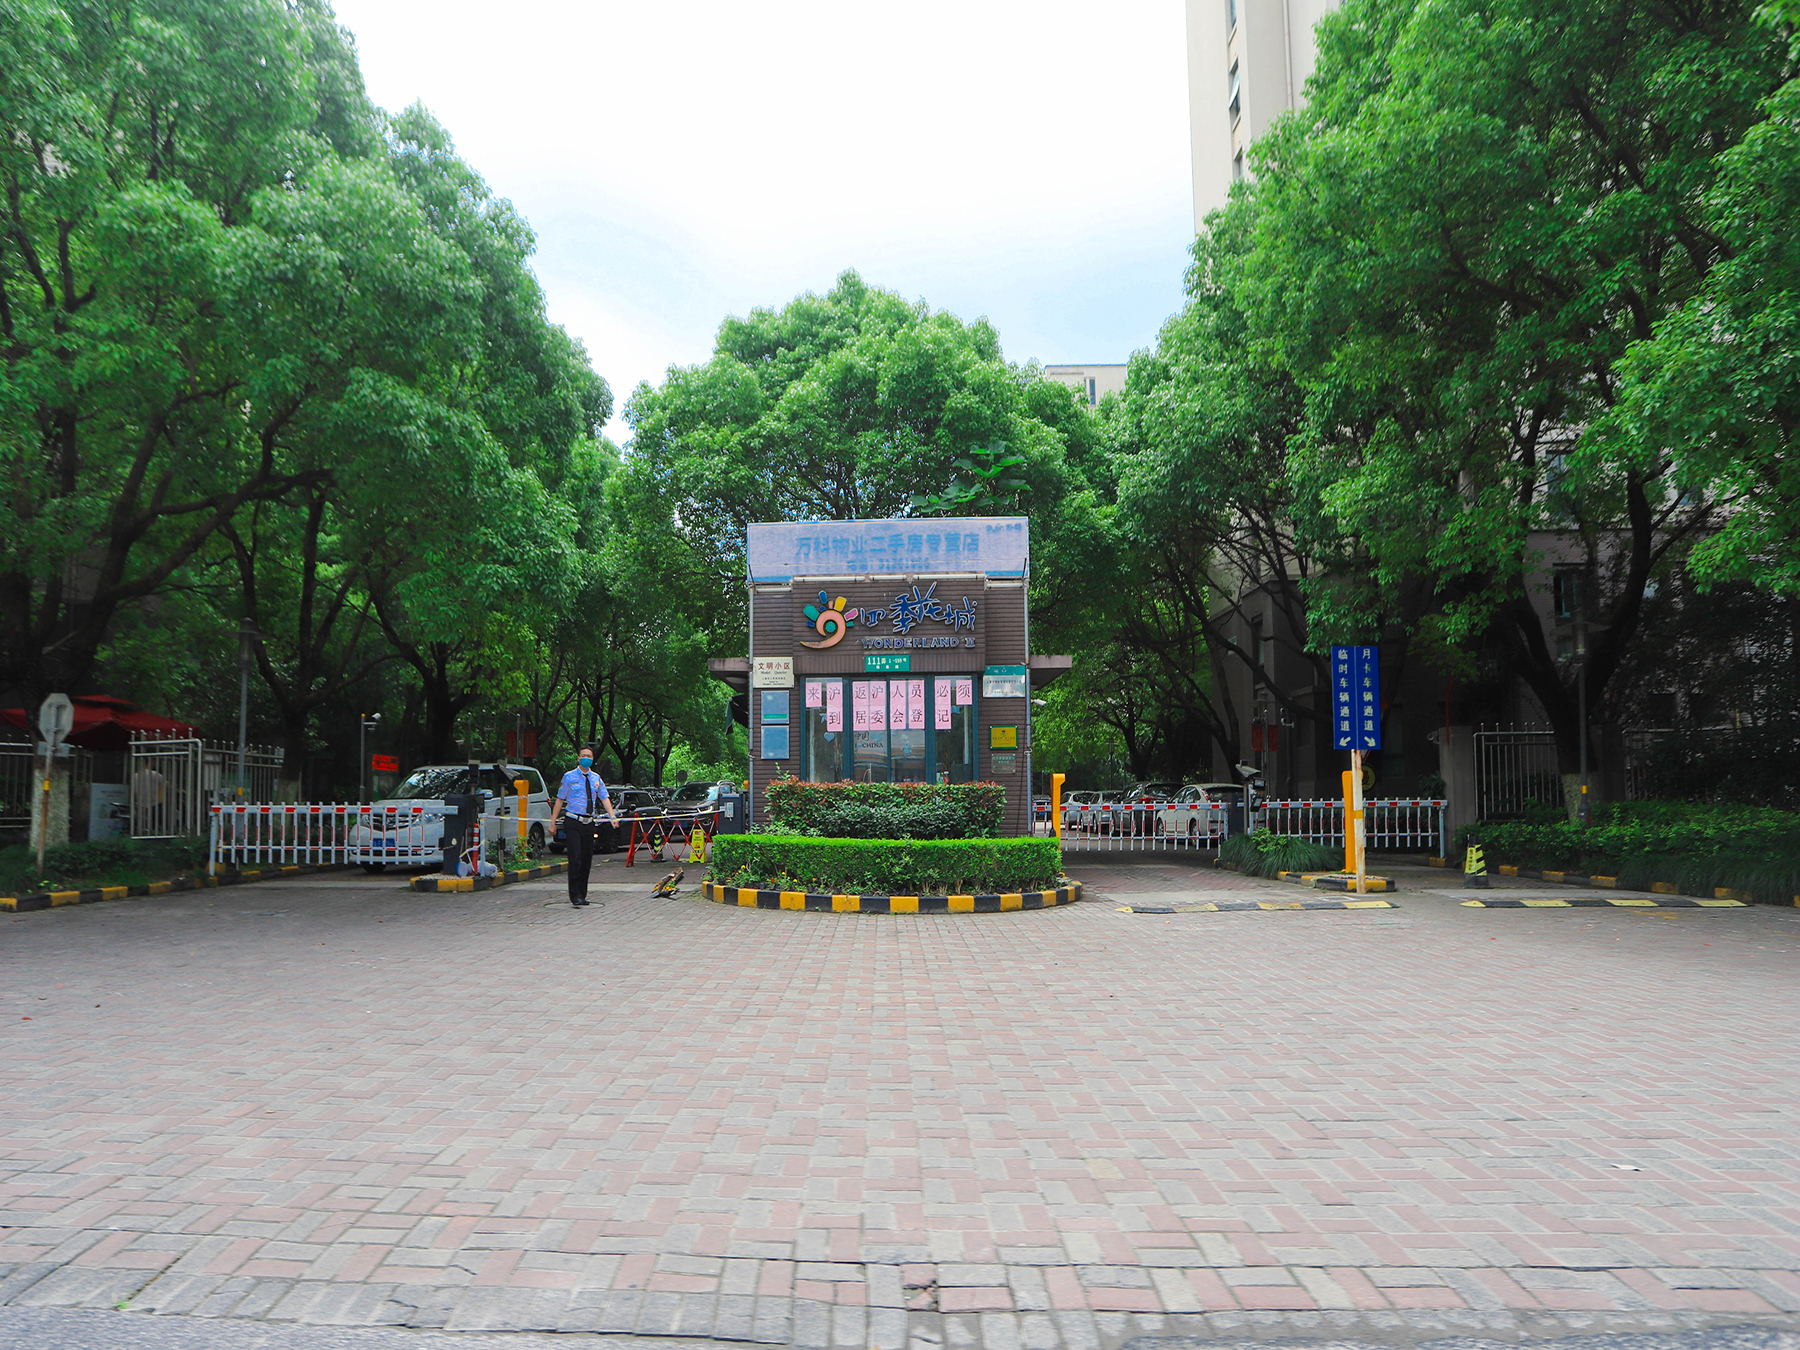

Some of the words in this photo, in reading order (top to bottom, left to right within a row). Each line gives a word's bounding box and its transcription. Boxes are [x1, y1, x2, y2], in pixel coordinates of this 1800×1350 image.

[796, 533, 981, 556] 万科物业二手房专营店
[860, 581, 978, 635] 四季花城
[861, 637, 959, 649] WONDERLAND
[757, 662, 790, 670] 文明小区
[1338, 648, 1350, 732] 临时车辆通道
[1362, 648, 1374, 731] 月卡车辆通道
[827, 708, 950, 725] 到居委会登记
